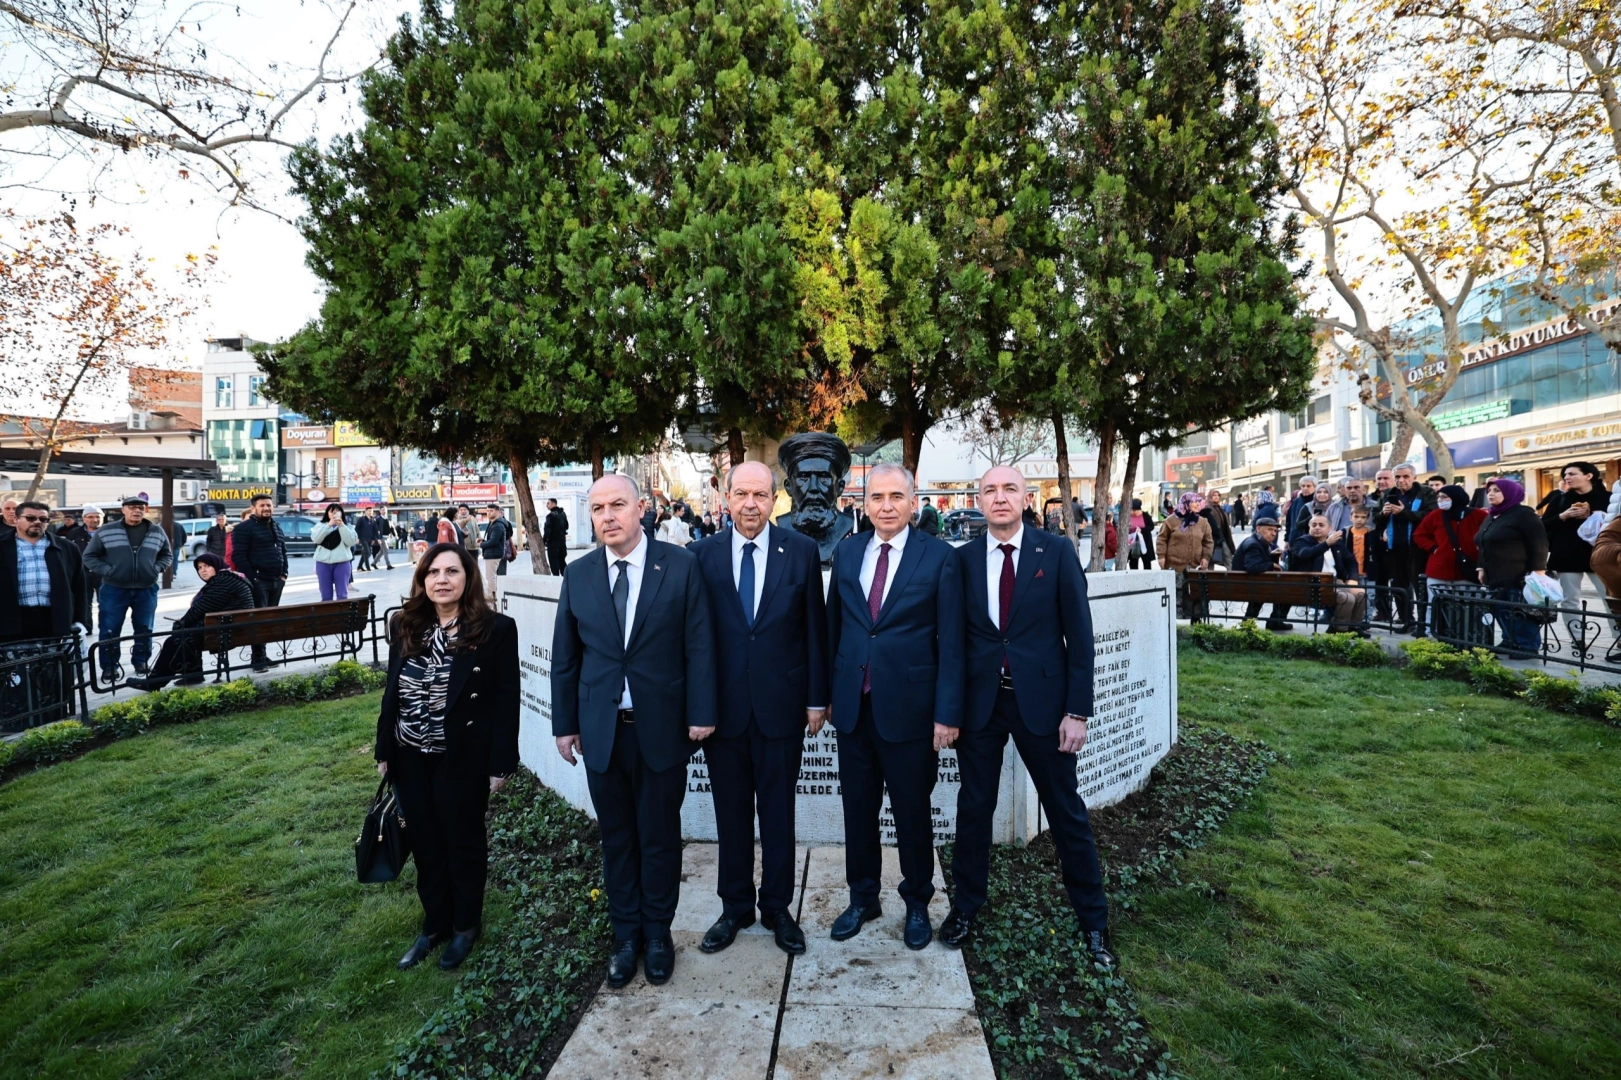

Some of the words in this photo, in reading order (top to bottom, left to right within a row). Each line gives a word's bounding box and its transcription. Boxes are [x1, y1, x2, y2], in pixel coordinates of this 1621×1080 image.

[287, 429, 327, 440] Doyuran
[209, 489, 240, 500] NOKTA
[456, 487, 492, 495] vodafone
